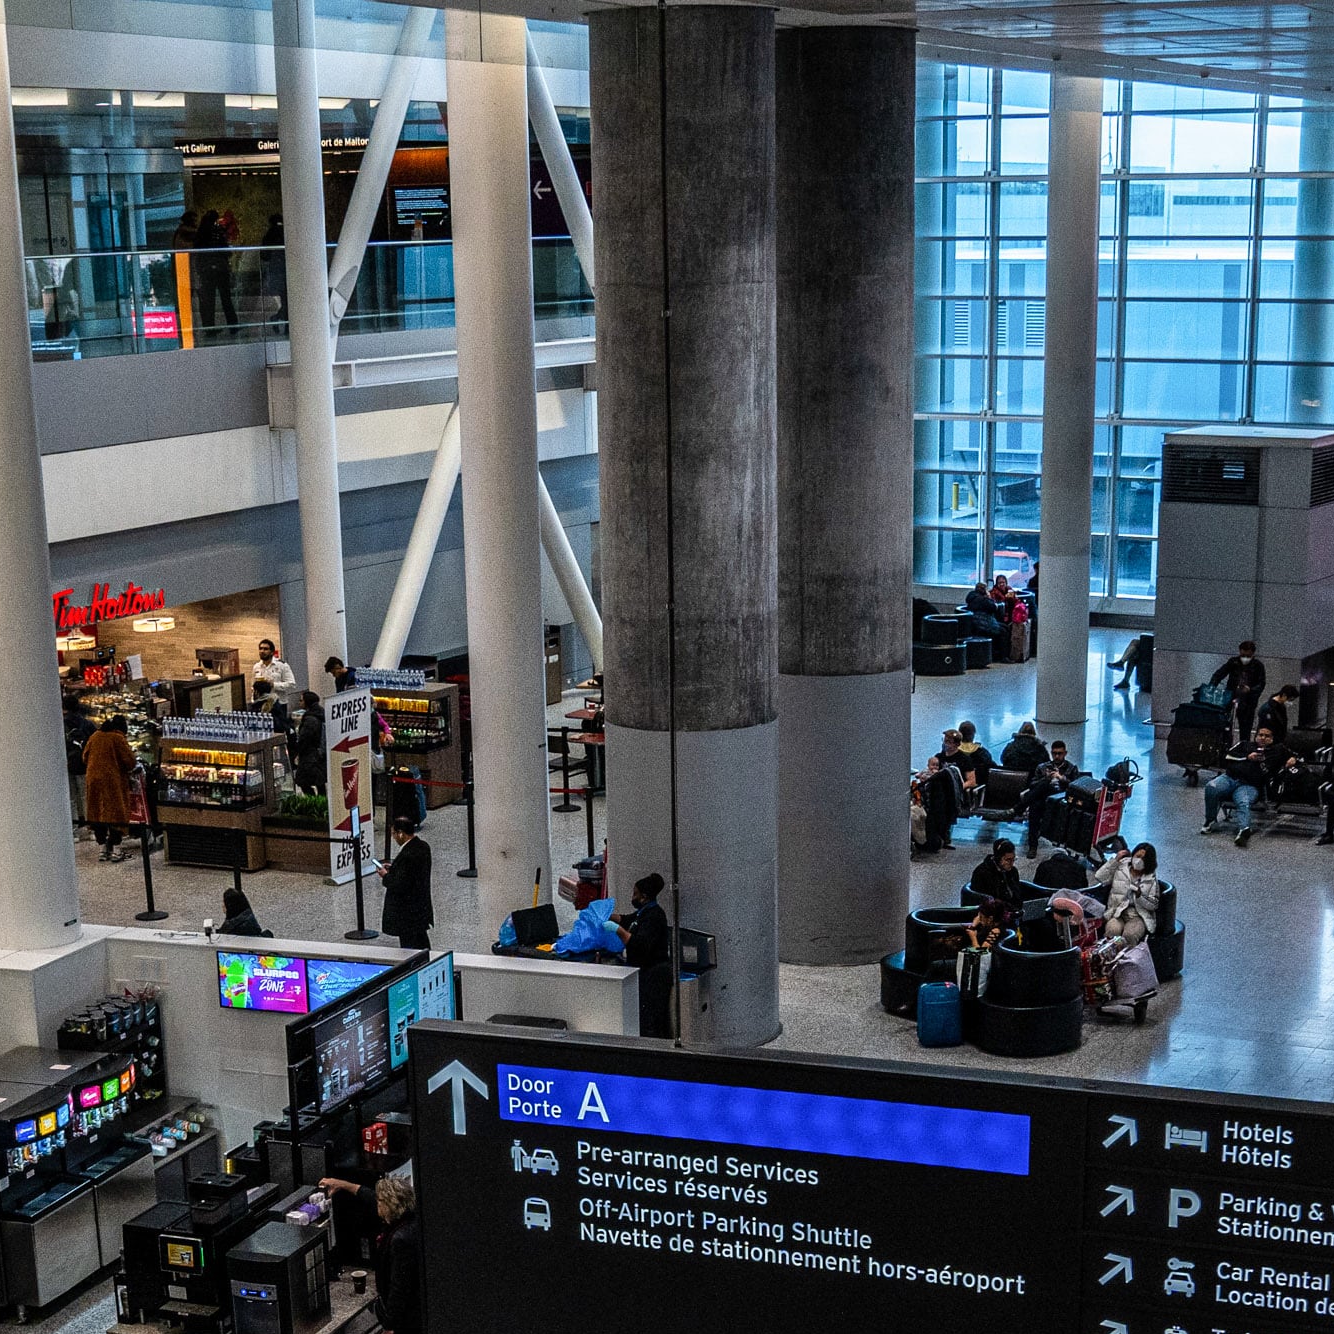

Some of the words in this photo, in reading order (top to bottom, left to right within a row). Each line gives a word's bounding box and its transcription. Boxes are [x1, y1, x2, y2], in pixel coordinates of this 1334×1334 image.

[191, 143, 216, 154] Gallery
[52, 588, 89, 628] Tim
[90, 581, 165, 623] Hortons
[331, 696, 367, 720] EXPRESS
[340, 715, 358, 734] LINE
[258, 979, 286, 993] ZONE
[508, 1073, 554, 1095] Door
[509, 1096, 562, 1119] Porte
[578, 1082, 609, 1123] A
[1223, 1121, 1293, 1145] Hotels
[578, 1141, 718, 1176] Pre-arranged
[726, 1158, 819, 1187] Services
[1221, 1144, 1292, 1169] Hôtels
[578, 1167, 668, 1194] Services
[675, 1177, 767, 1205] réservés
[1168, 1188, 1201, 1228] P
[1219, 1192, 1301, 1222] Parking
[1308, 1202, 1324, 1222] &
[580, 1198, 695, 1234] Off-Airport
[702, 1212, 784, 1242] Parking
[792, 1221, 872, 1249] Shuttle
[580, 1226, 662, 1250] Navette
[669, 1233, 695, 1253] de
[701, 1236, 861, 1274] stationnement
[868, 1256, 1026, 1295] hors-aéroport
[1216, 1262, 1254, 1283] Car
[1260, 1266, 1330, 1291] Rental
[1215, 1284, 1308, 1312] Location
